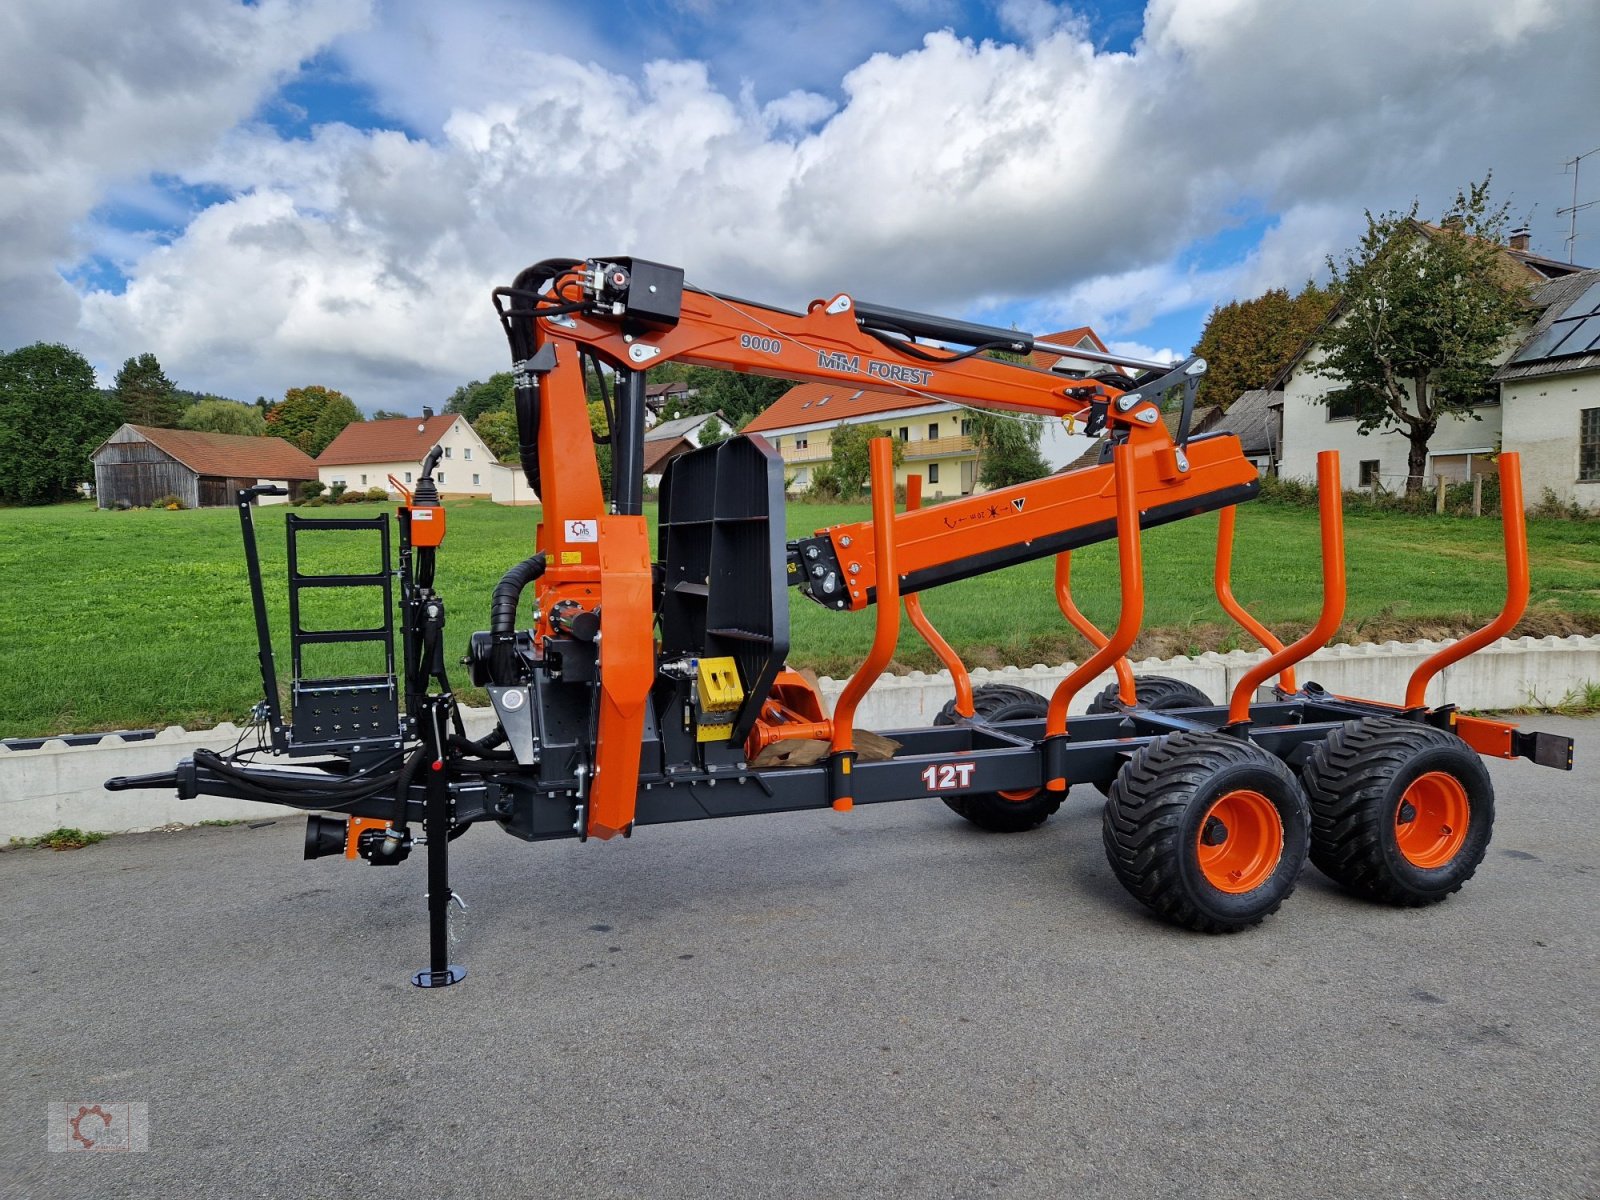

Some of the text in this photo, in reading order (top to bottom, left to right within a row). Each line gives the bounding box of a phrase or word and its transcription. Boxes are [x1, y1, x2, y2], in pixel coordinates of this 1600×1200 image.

[741, 334, 781, 353] 9000
[818, 350, 933, 386] MTM FOREST
[922, 762, 975, 791] 12T
